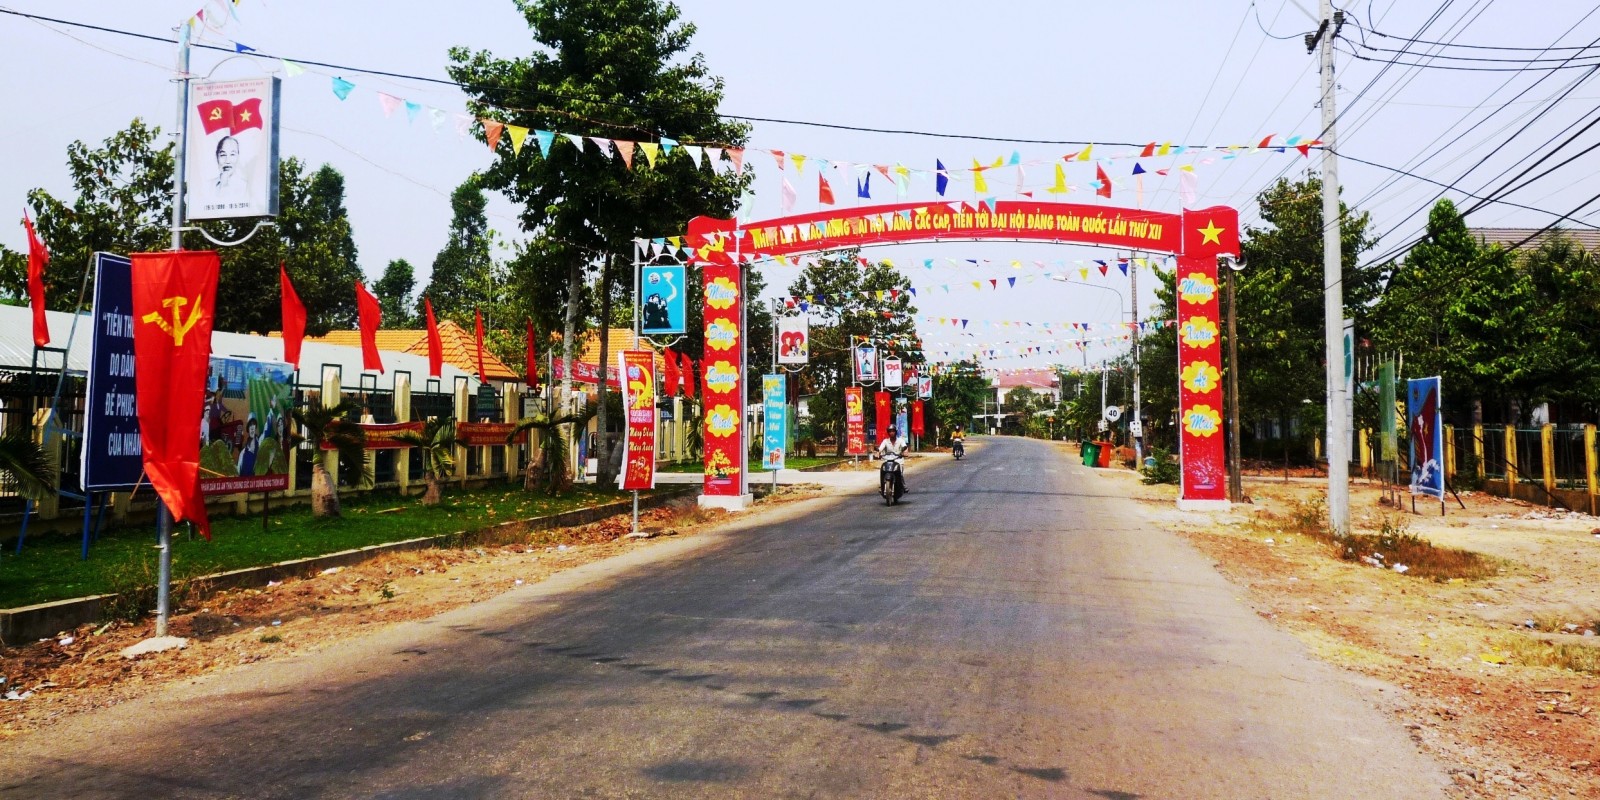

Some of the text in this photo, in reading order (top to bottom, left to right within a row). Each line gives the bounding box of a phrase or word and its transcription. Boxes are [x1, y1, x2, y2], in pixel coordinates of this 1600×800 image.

[780, 224, 798, 246] LT
[800, 220, 822, 242] CÀO
[953, 206, 972, 228] TIẾN
[991, 213, 1007, 232] ĐẠI
[1010, 208, 1025, 233] HỘI
[1028, 208, 1054, 230] ĐẢNG
[1056, 211, 1080, 231] TOÀN
[1082, 211, 1106, 234] QUỐC
[1129, 218, 1149, 238] THỨ
[1148, 223, 1162, 240] XII
[109, 350, 136, 378] DO DÂN
[116, 393, 135, 422] PHỤC
[108, 425, 142, 456] CỦA NHÂN
